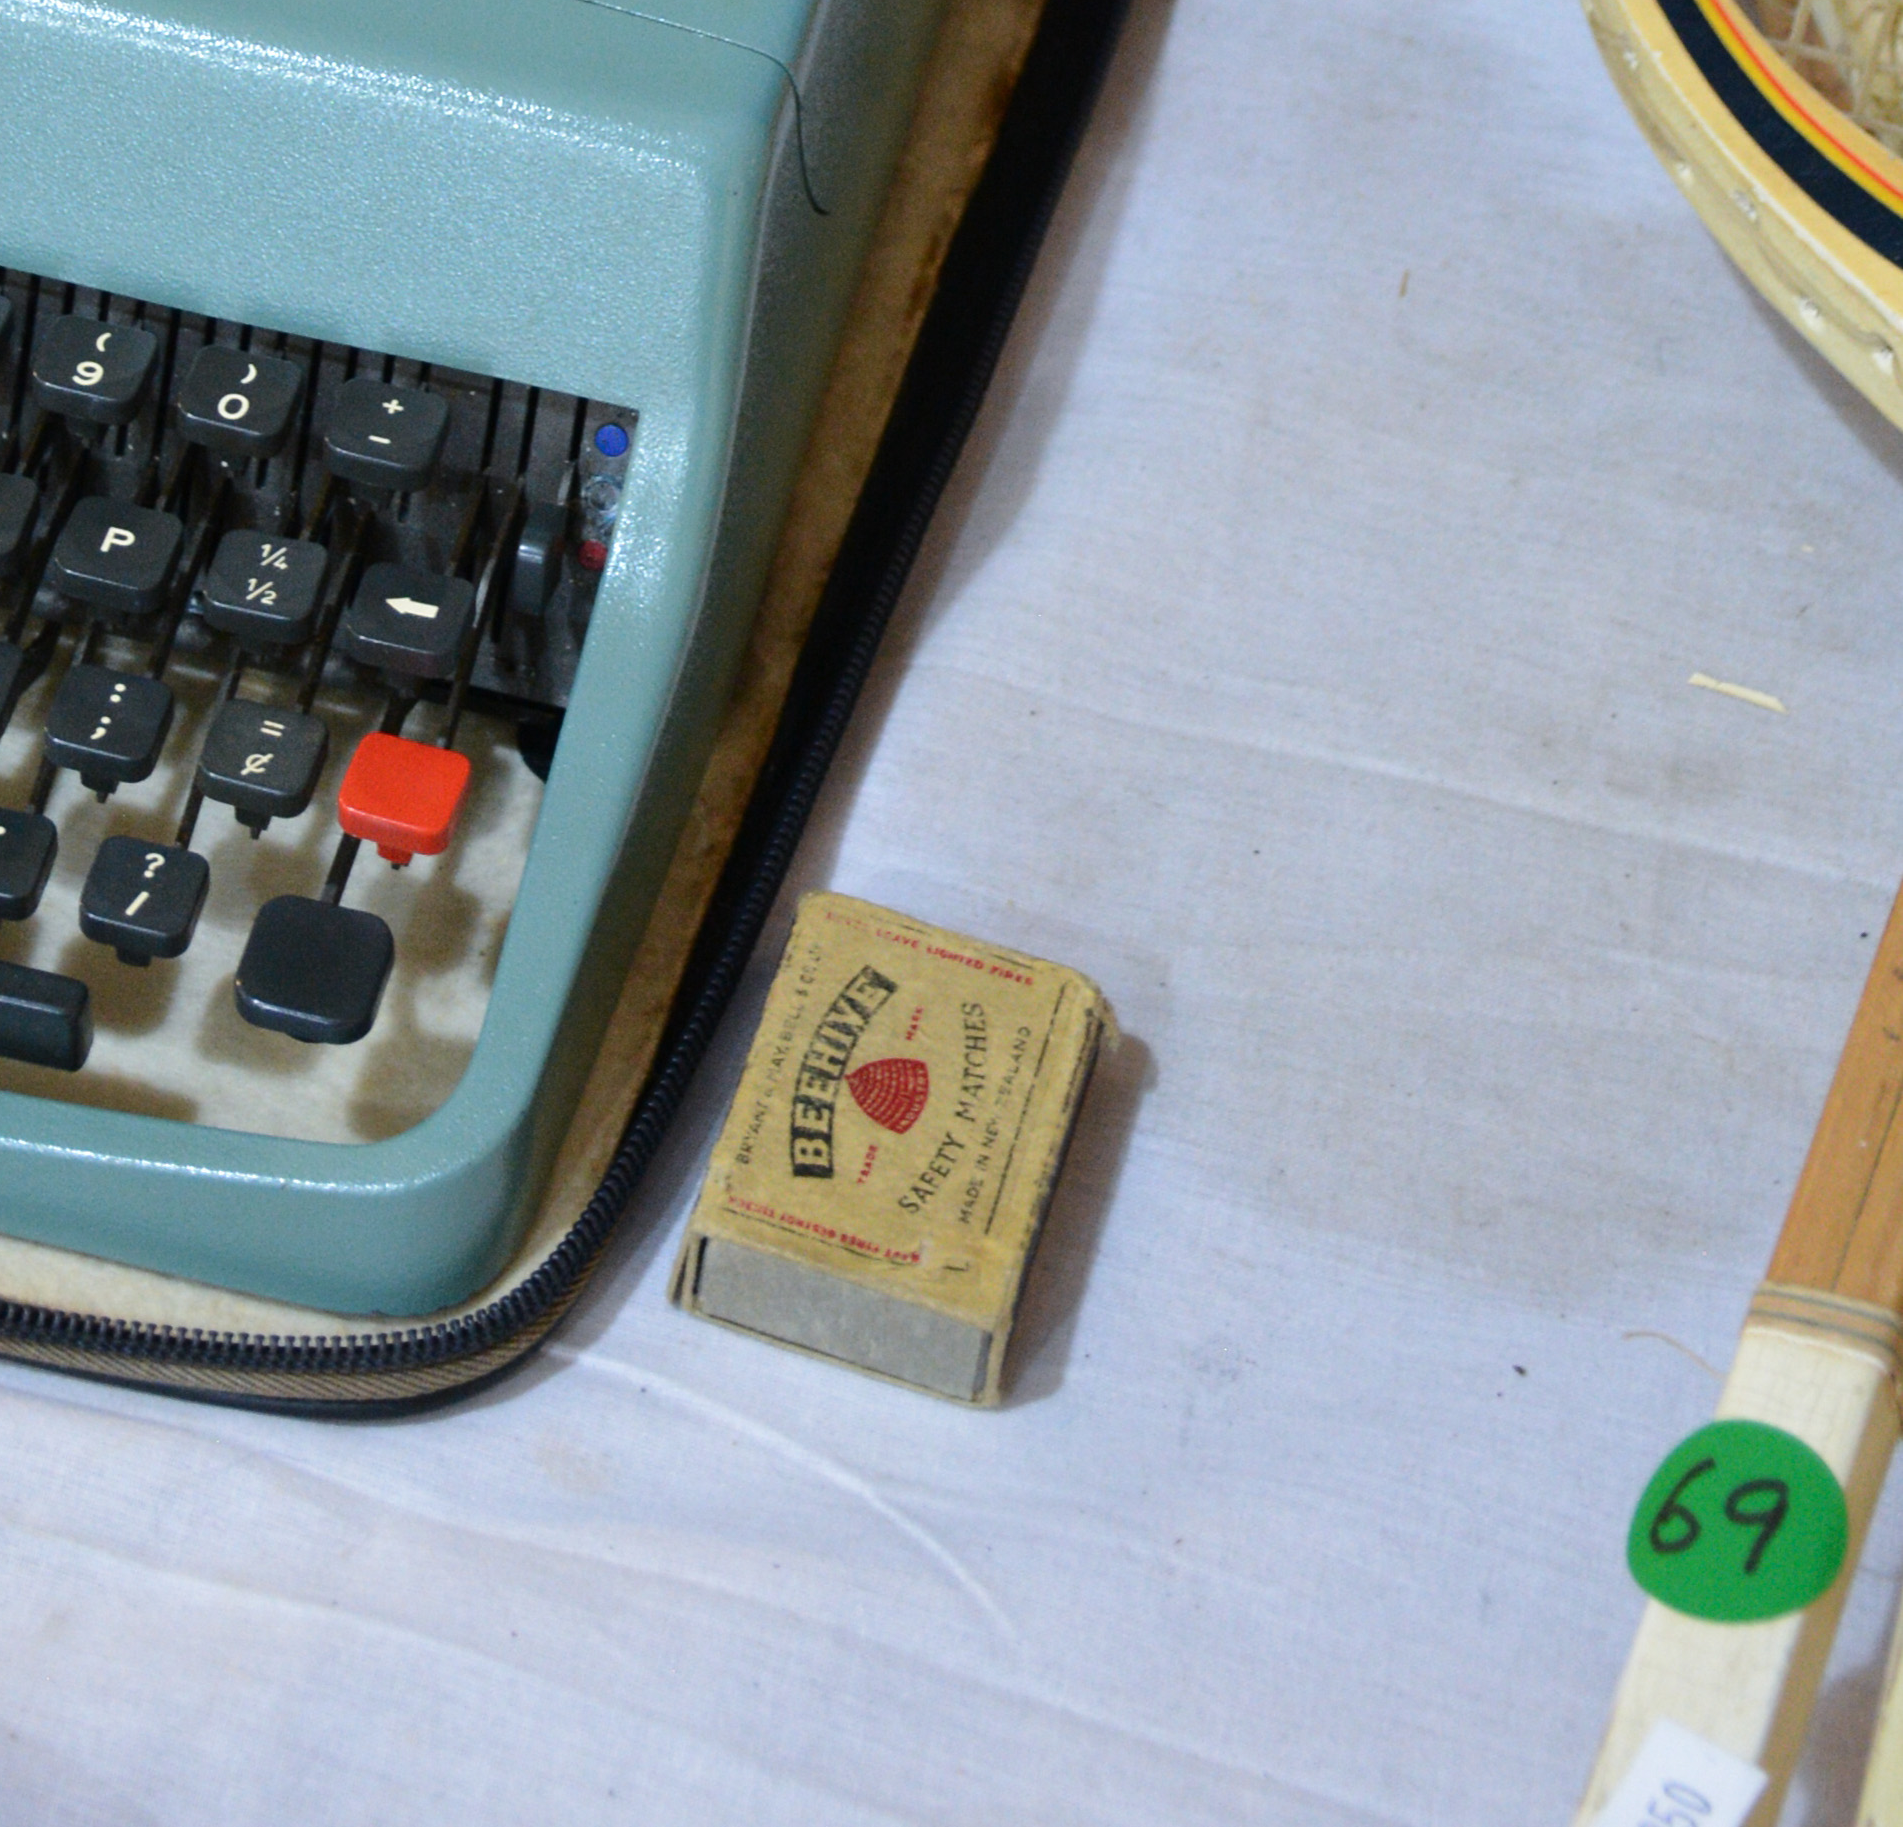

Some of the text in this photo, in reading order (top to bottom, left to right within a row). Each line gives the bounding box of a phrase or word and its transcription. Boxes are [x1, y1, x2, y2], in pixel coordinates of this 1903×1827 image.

[72, 361, 104, 386] 9
[100, 526, 136, 553] P
[143, 852, 166, 879] ?
[795, 974, 890, 1168] BEEHIVE
[857, 1007, 923, 1185] TRADE MARK
[899, 1131, 966, 1214] SAFETY
[959, 1002, 988, 1124] MATCHES
[958, 1177, 984, 1224] MADE
[974, 1153, 991, 1171] IN
[1649, 1457, 1790, 1576] 69
